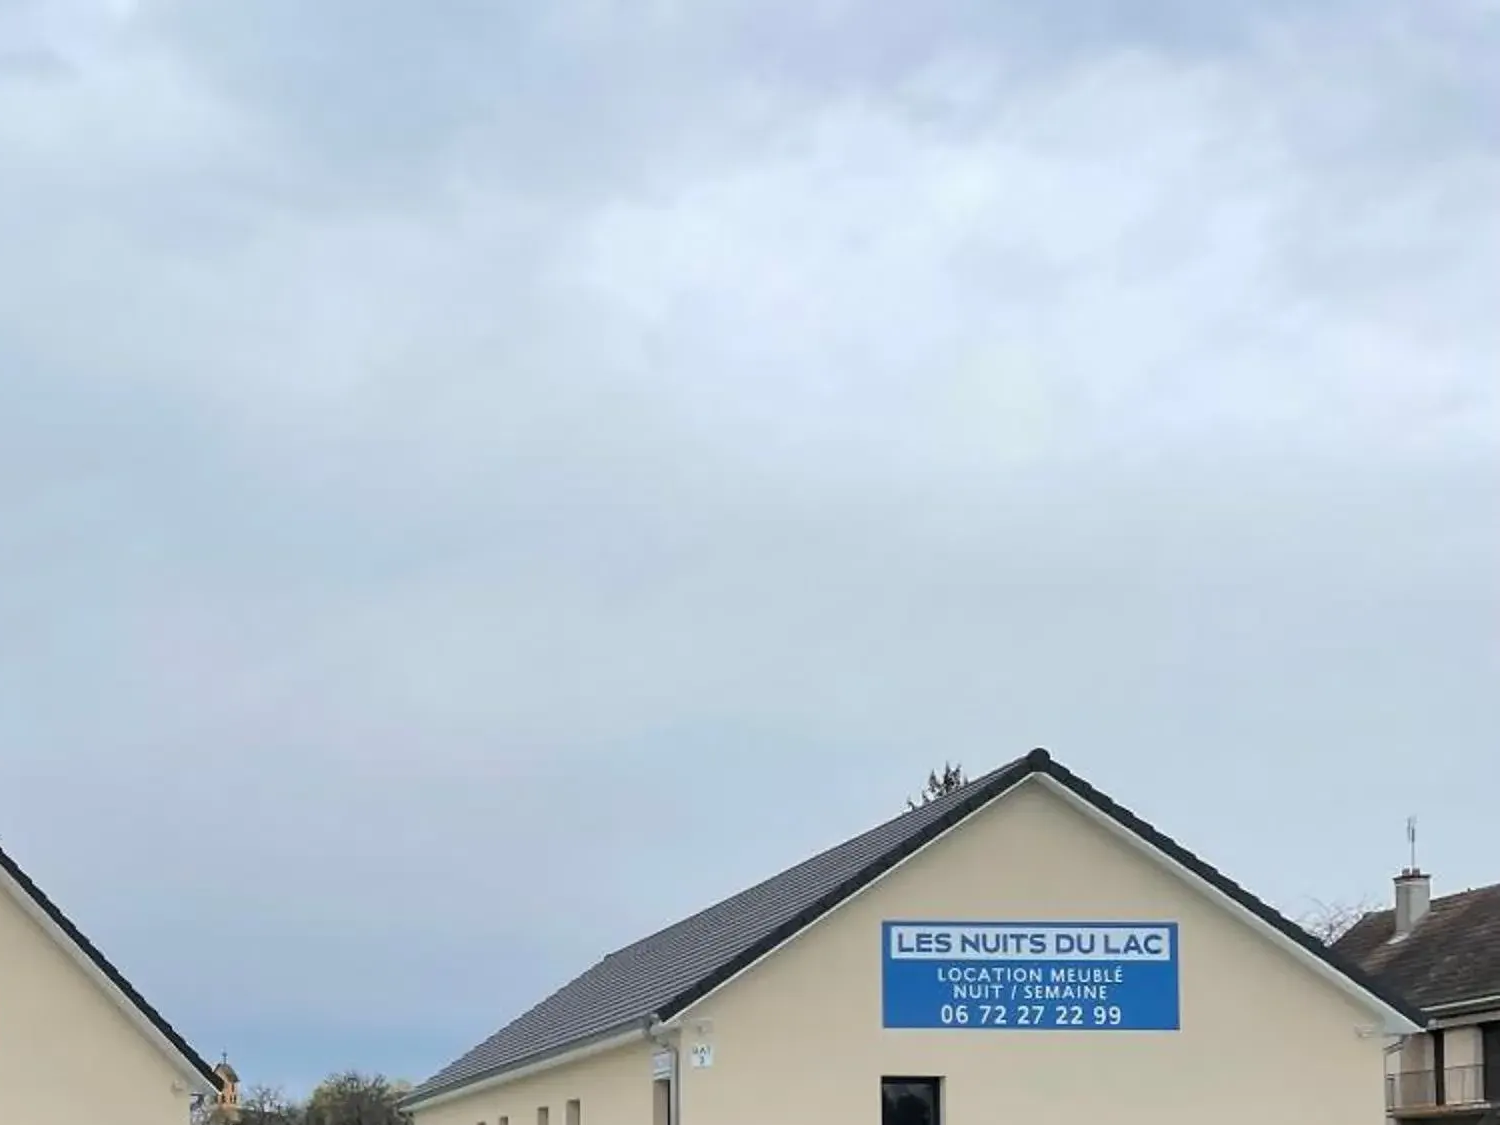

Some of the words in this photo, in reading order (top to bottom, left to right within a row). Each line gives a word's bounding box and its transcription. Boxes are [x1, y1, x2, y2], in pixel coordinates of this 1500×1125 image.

[897, 932, 952, 953] LES
[961, 933, 1047, 954] NUITS
[1056, 933, 1095, 954] DU
[1104, 933, 1163, 954] LAC
[937, 967, 1043, 982] LOCATION
[1051, 965, 1123, 983] MEUBLÉ
[953, 984, 1004, 999] NUIT
[1011, 984, 1017, 1000] /
[1024, 984, 1108, 1000] SEMAINE
[940, 1004, 969, 1024] 06
[979, 1005, 1007, 1024] 72
[1017, 1005, 1045, 1024] 27
[1055, 1005, 1084, 1024] 22
[1093, 1005, 1122, 1025] 99
